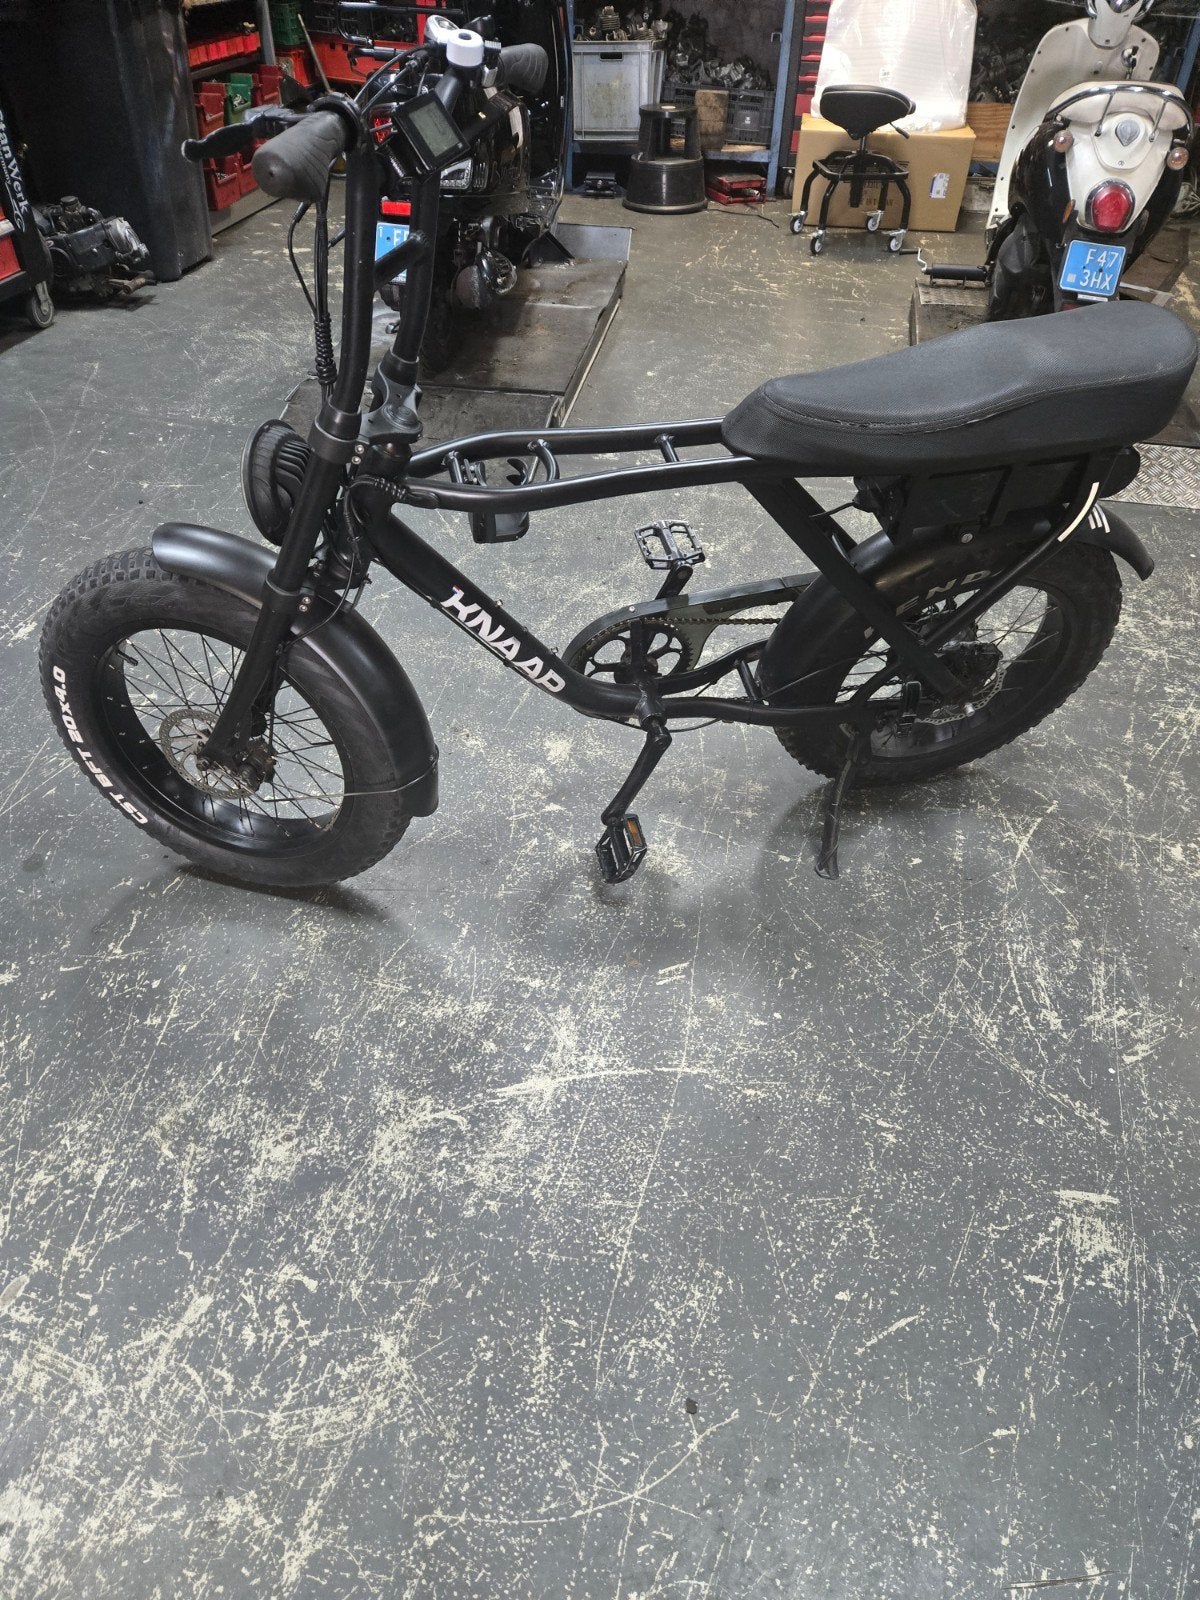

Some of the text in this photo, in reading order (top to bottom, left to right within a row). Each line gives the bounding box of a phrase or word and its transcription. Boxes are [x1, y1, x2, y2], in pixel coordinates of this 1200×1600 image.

[1086, 248, 1119, 268] F47
[1080, 269, 1113, 291] 3HX
[440, 585, 566, 693] KNAAP
[76, 747, 113, 788] BFT
[109, 791, 148, 824] CST
